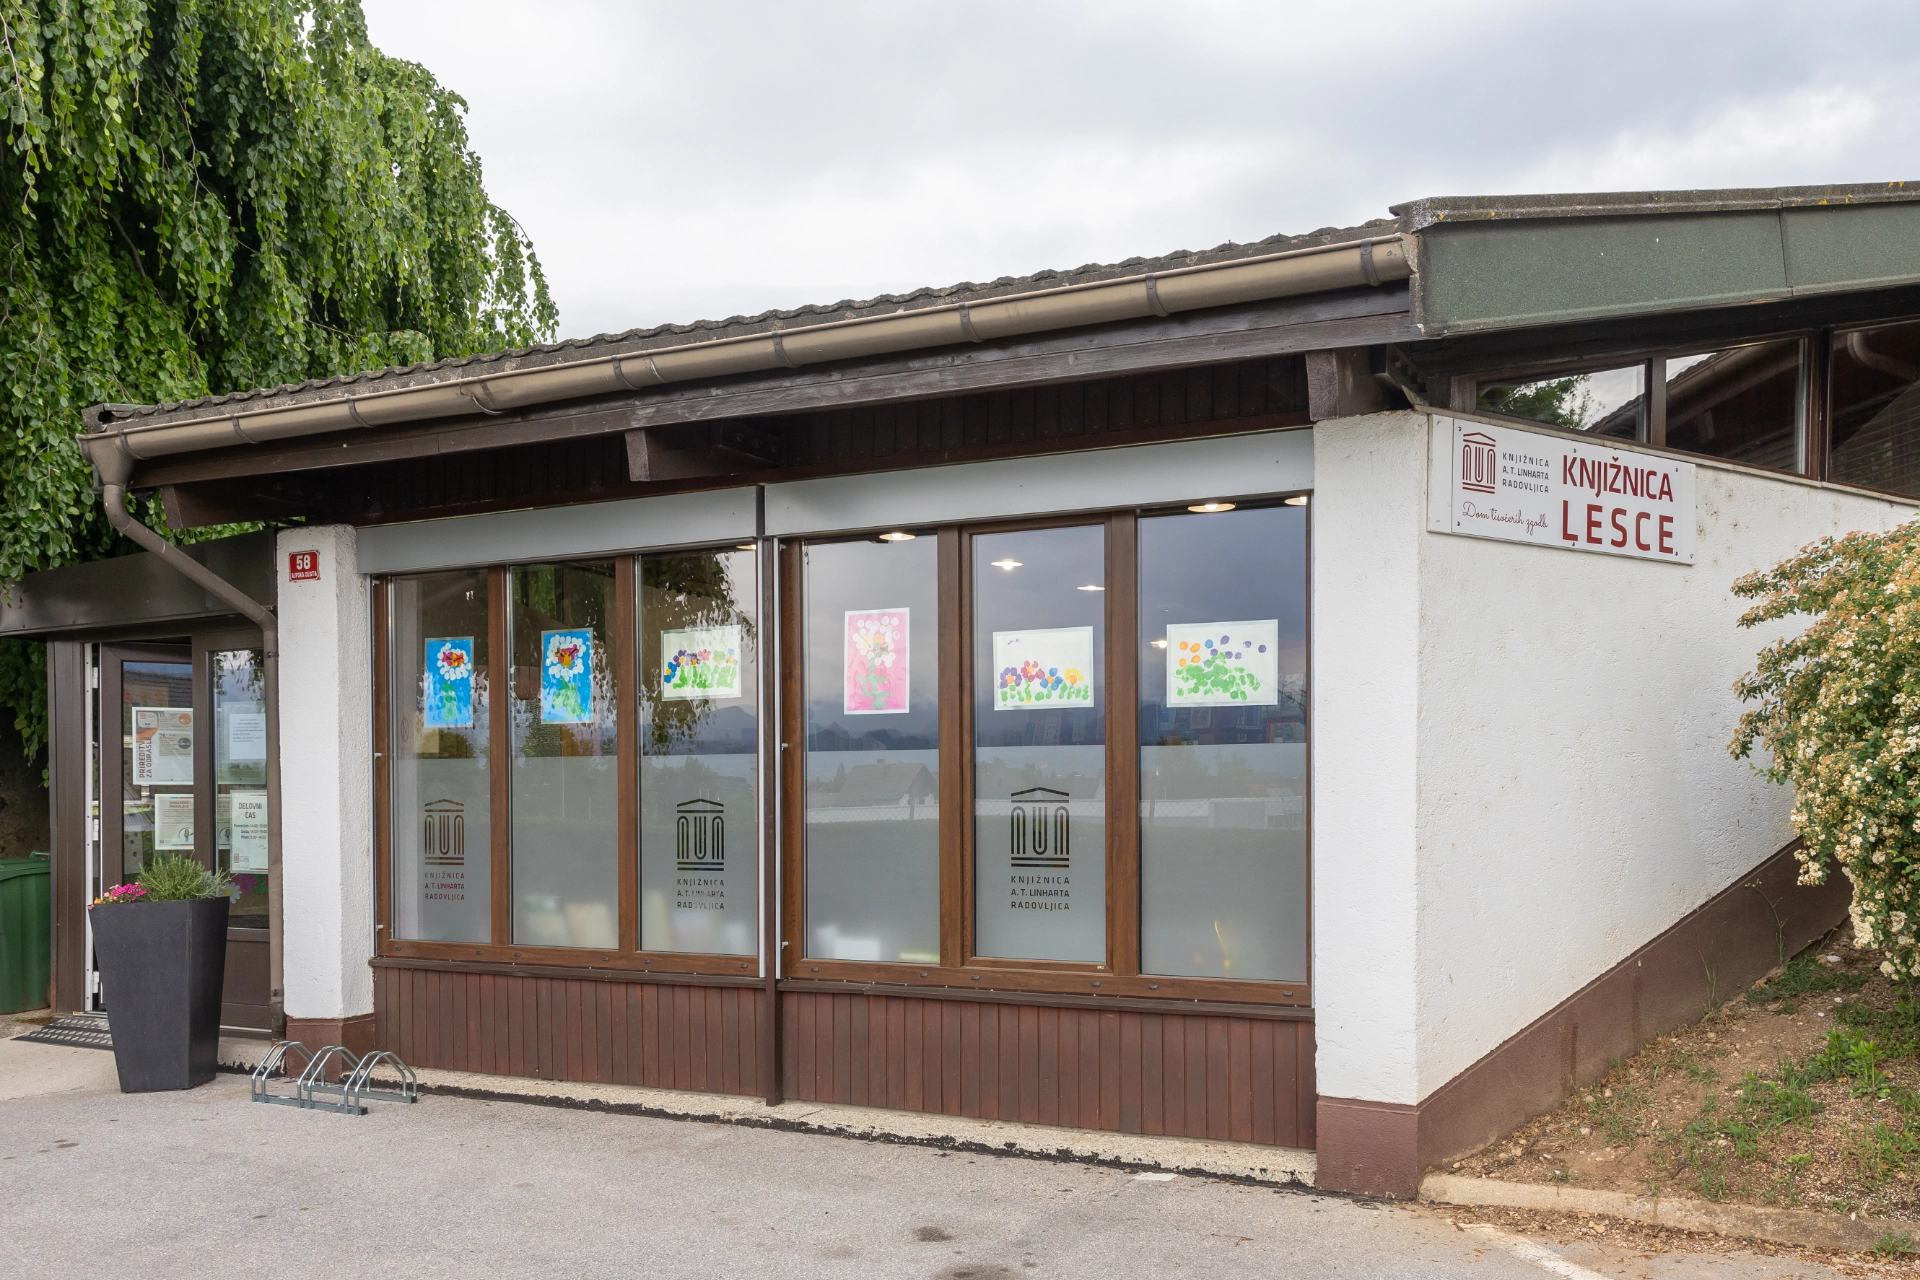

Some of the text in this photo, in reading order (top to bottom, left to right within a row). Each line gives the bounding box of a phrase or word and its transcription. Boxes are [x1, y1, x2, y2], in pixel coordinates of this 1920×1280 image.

[1502, 452, 1550, 468] KNJIŽNICA
[1502, 465, 1550, 481] A. T. LINHARTA
[1562, 454, 1673, 502] KNJIŽNICA
[1502, 478, 1549, 493] RADOVLJICA
[1462, 501, 1489, 520] Dom
[1526, 513, 1548, 536] zgodb
[1562, 499, 1674, 554] LESCE
[296, 554, 311, 570] 58
[146, 768, 152, 778] ZA
[238, 802, 263, 810] DELOVNI
[244, 810, 256, 819] ČAS
[424, 871, 465, 879] KNJIŽNICA
[1010, 875, 1070, 885] KNJIŽNICA
[677, 878, 725, 887] KNJIŽNICA
[424, 892, 465, 901] RADOVLJICA
[677, 889, 684, 897] A.
[1010, 888, 1070, 898] A. T. LINHARTA
[1010, 901, 1070, 912] RADOVLJICA
